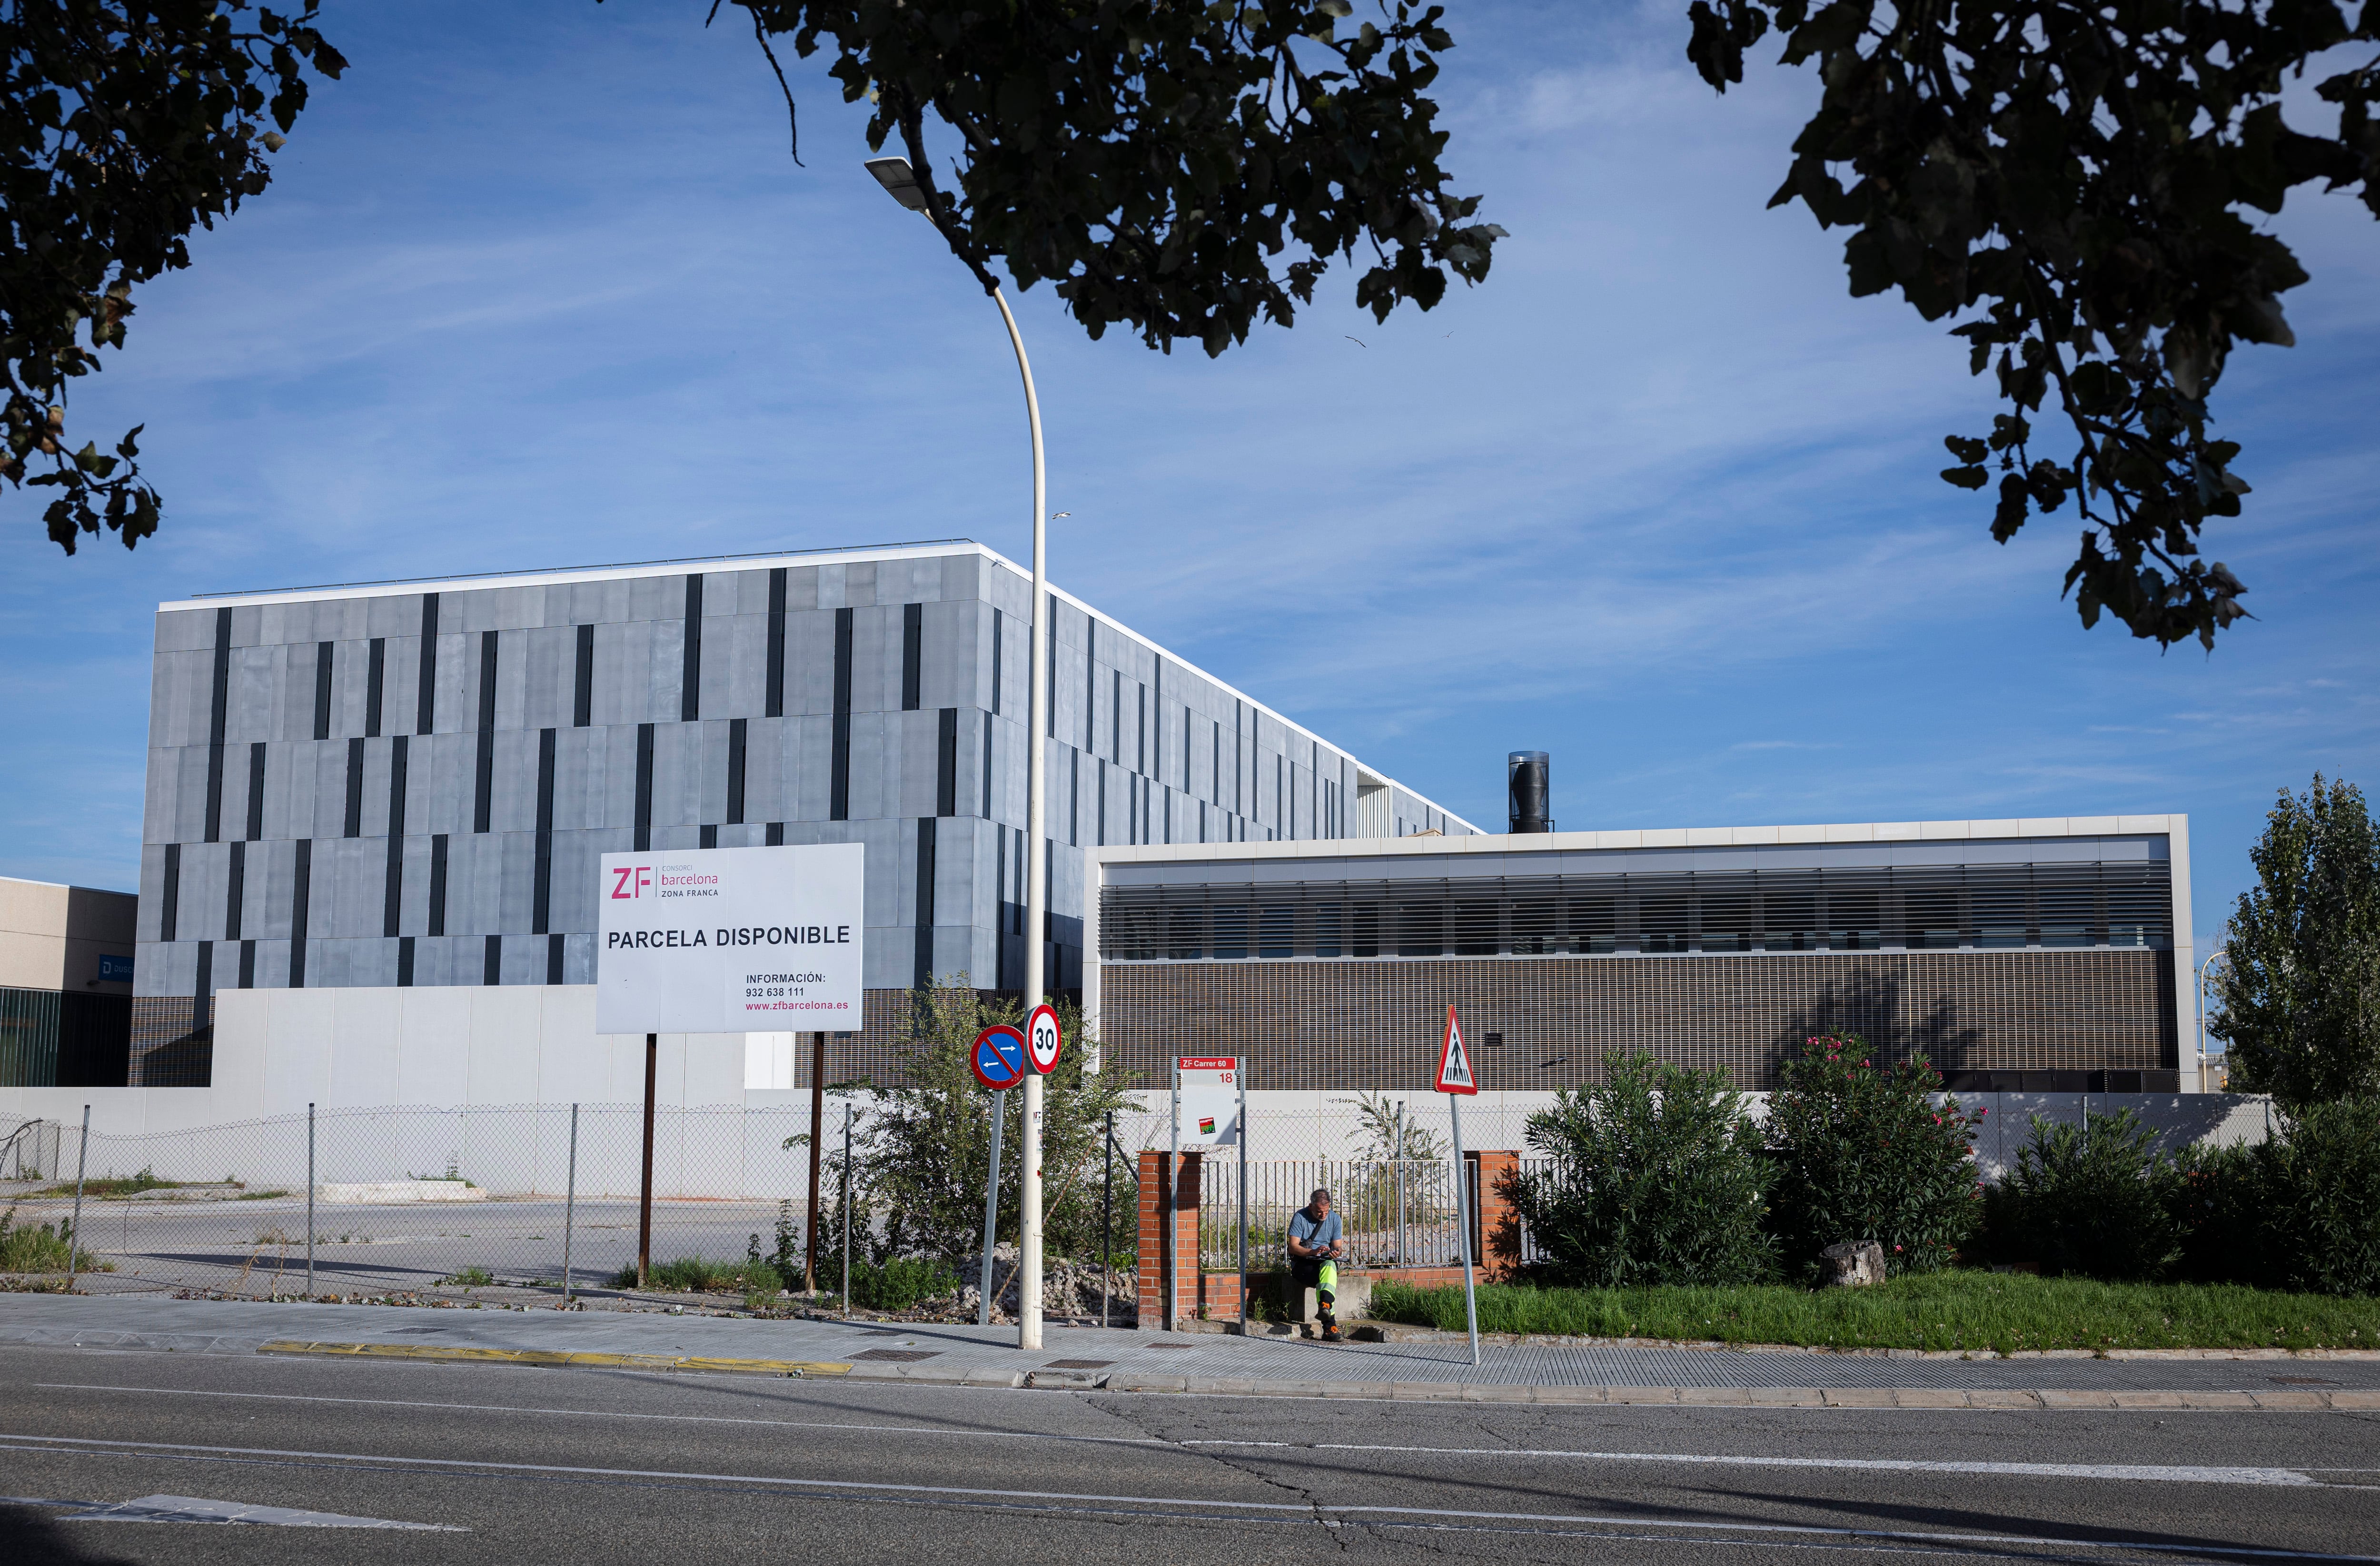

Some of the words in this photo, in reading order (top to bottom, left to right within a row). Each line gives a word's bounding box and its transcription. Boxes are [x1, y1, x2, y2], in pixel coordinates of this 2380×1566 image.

[611, 867, 651, 899] ZF
[661, 873, 718, 885] barcelona
[608, 929, 708, 949] PARCELA
[716, 925, 850, 946] DISPONIBLE
[746, 971, 826, 984] INFORMACIÓN:
[746, 988, 763, 997] 932
[766, 988, 784, 997] 638
[788, 987, 804, 996] 111
[745, 1001, 848, 1011] www.zfbarcelona.es
[1035, 1027, 1054, 1051] 30
[1182, 1060, 1192, 1068] ZF
[1219, 1072, 1233, 1083] 18
